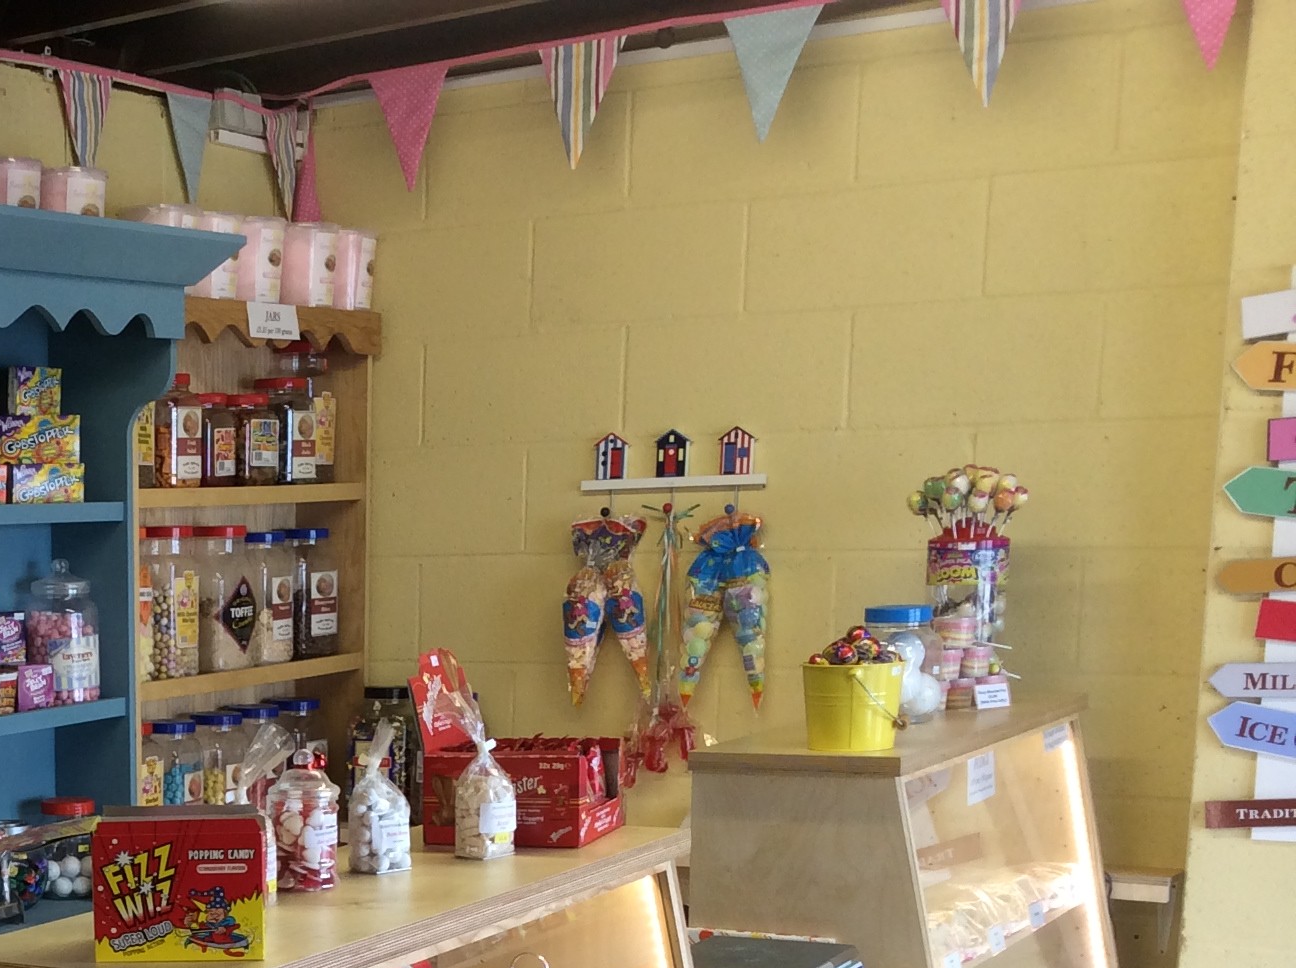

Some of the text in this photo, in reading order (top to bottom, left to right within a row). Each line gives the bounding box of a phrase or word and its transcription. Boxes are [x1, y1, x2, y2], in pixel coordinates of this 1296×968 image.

[265, 311, 281, 322] JARS
[230, 606, 254, 618] TOFFEE
[1235, 716, 1288, 746] ICE
[102, 843, 176, 896] FIZZ
[188, 849, 255, 860] POPPING CANDY
[113, 879, 172, 928] WIZ
[110, 920, 174, 951] SUPER LOUD
